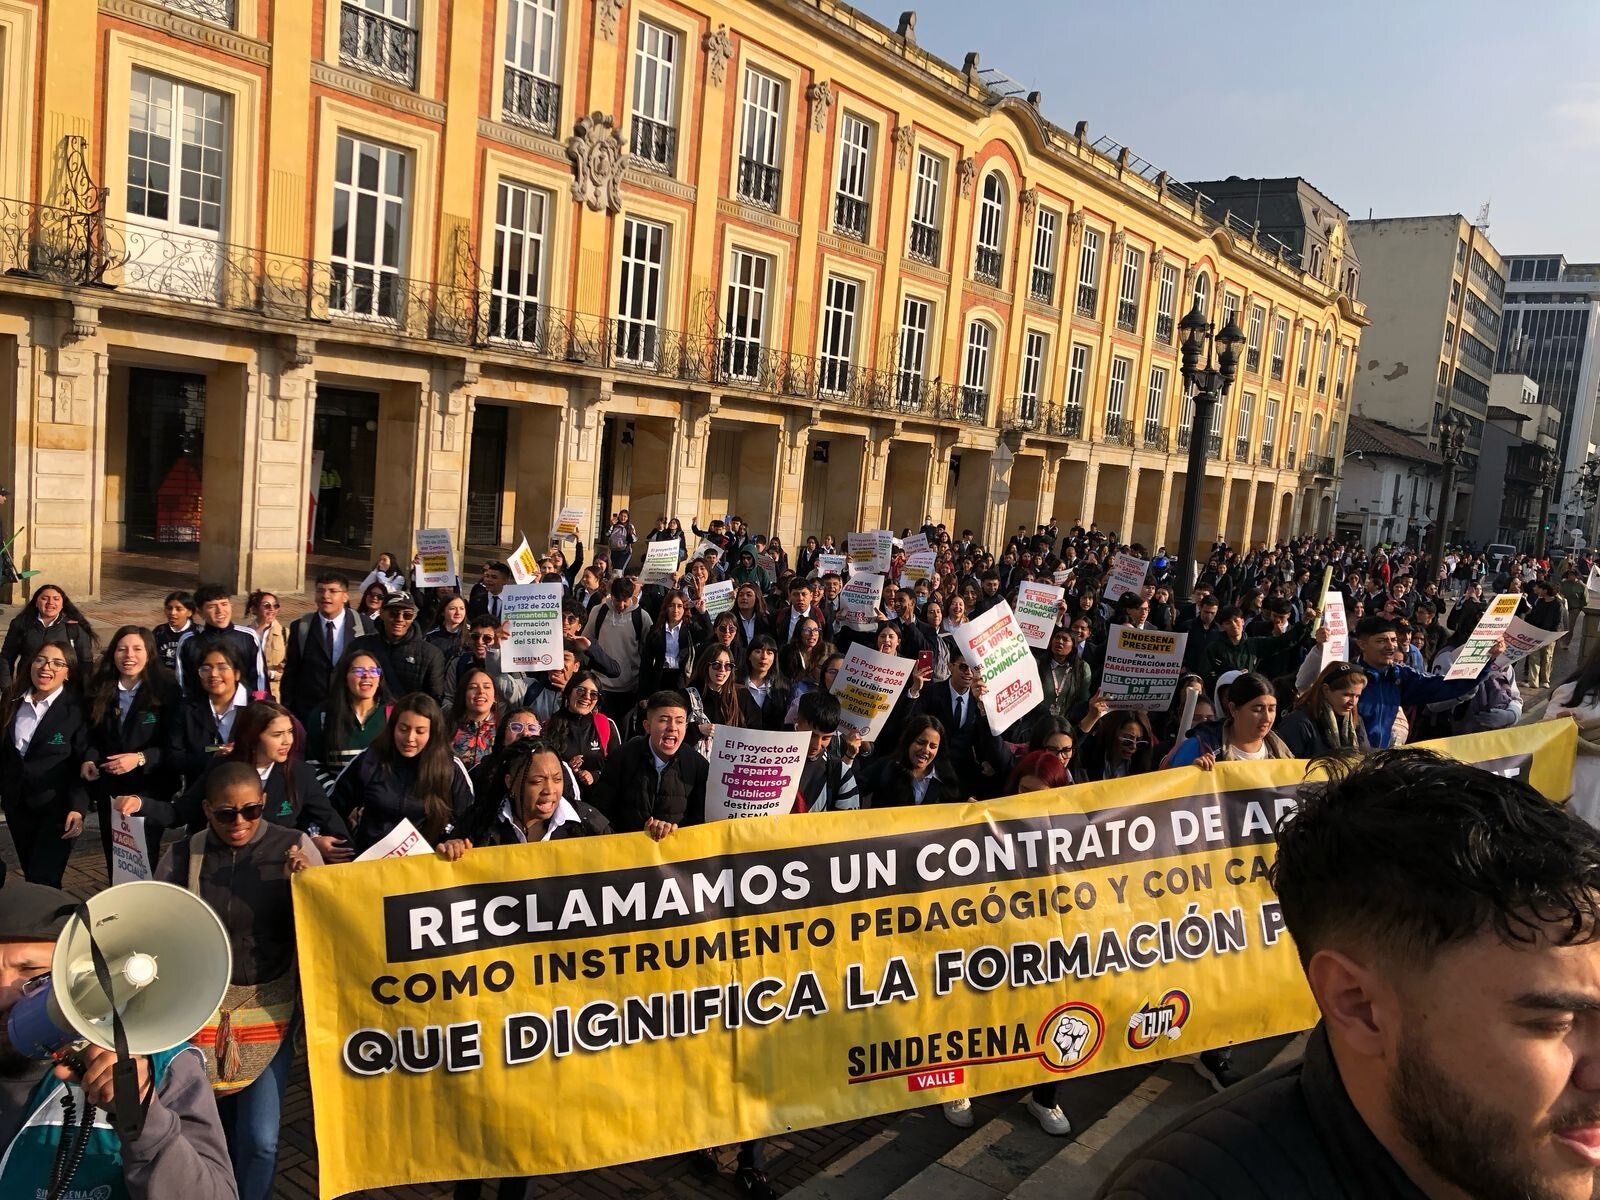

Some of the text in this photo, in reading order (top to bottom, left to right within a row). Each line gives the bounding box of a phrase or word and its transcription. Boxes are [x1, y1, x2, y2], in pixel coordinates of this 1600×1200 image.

[515, 594, 546, 603] proyecto
[1036, 596, 1053, 605] 100%
[504, 604, 515, 612] Ley
[1018, 607, 1054, 620] DOMINICAL
[1026, 601, 1058, 613] RECARGO
[513, 620, 550, 629] formación
[512, 629, 552, 639] profesional
[988, 627, 1013, 648] 100%
[1122, 631, 1175, 645] SINDESENA
[526, 637, 550, 645] SENA.
[1122, 640, 1172, 652] PRESENTE
[851, 656, 906, 677] El Proyecto de
[981, 646, 1029, 684] DOMINICAL
[1145, 666, 1181, 675] LABORAL
[1167, 661, 1181, 669] DEL
[845, 664, 903, 687] Ley 132 de 2024
[1105, 674, 1176, 686] DEL CONTRATO
[846, 675, 894, 695] del Uribismo
[1009, 682, 1020, 694] LO
[1132, 686, 1146, 694] DE
[836, 690, 890, 711] autonomía del
[850, 687, 883, 701] afecta la
[1104, 691, 1169, 701] APRENDIZAJE
[725, 739, 799, 755] El Proyecto de
[718, 750, 801, 765] Ley 132 de 2024
[738, 766, 779, 777] reparte
[724, 773, 788, 788] los recursos
[732, 788, 777, 799] públicos
[723, 800, 781, 811] destinados
[410, 860, 811, 950] RECLAMAMOS
[830, 848, 897, 893] UN
[916, 814, 1157, 884] CONTRATO
[1171, 804, 1225, 847] DE
[371, 960, 515, 1006] COMO
[534, 917, 836, 986] INSTRUMENTO
[852, 885, 1097, 942] PEDAGÓGICO
[1112, 876, 1129, 905] Y
[1143, 862, 1214, 900] CON
[343, 900, 1290, 1075] QUE DIGNIFICA LA FORMACIÓN P
[1141, 1008, 1174, 1039] CUT
[848, 1022, 1033, 1078] SINDESENA
[916, 1071, 957, 1089] VALLE
